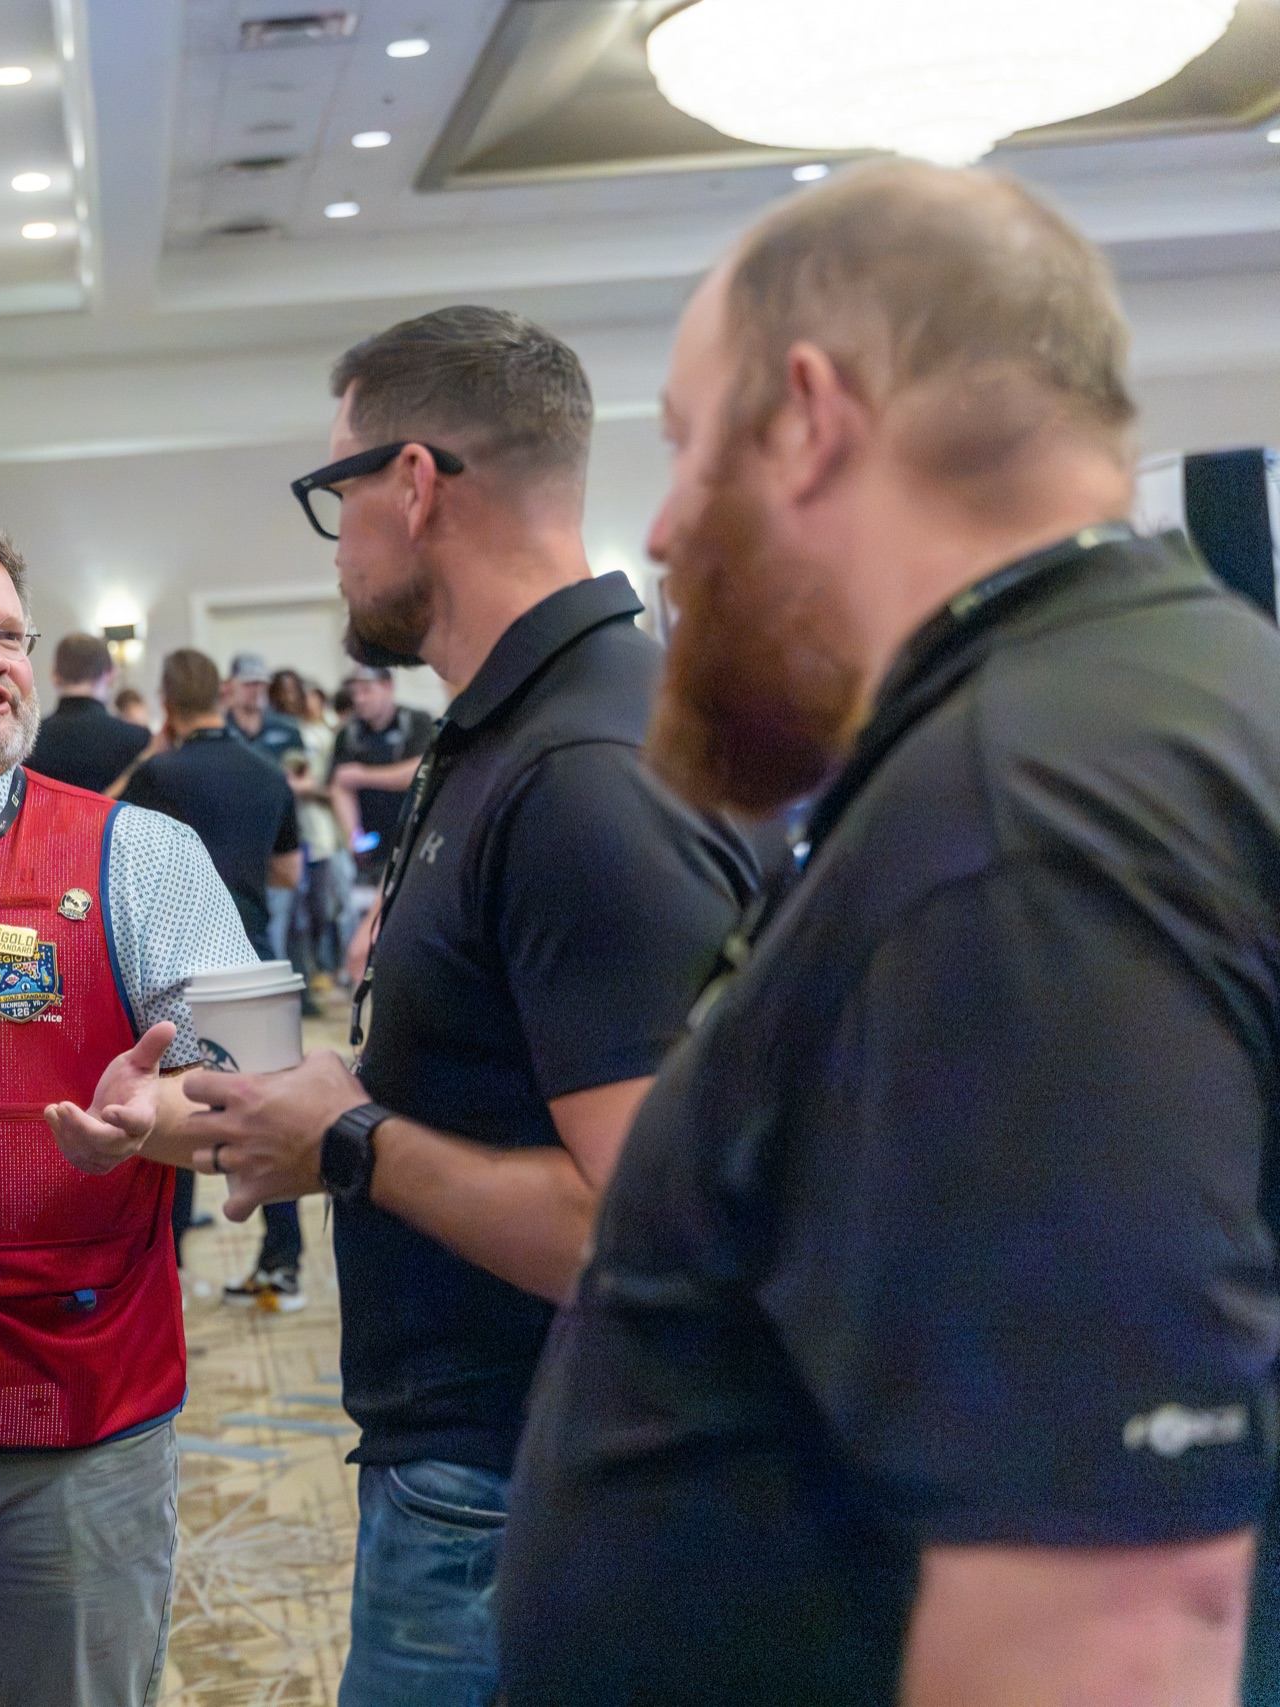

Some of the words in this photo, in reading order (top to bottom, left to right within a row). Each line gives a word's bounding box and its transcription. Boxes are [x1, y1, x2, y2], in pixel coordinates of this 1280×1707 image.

[1, 931, 35, 947] GOLD
[3, 994, 19, 1002] GOLD
[12, 1008, 30, 1018] 126
